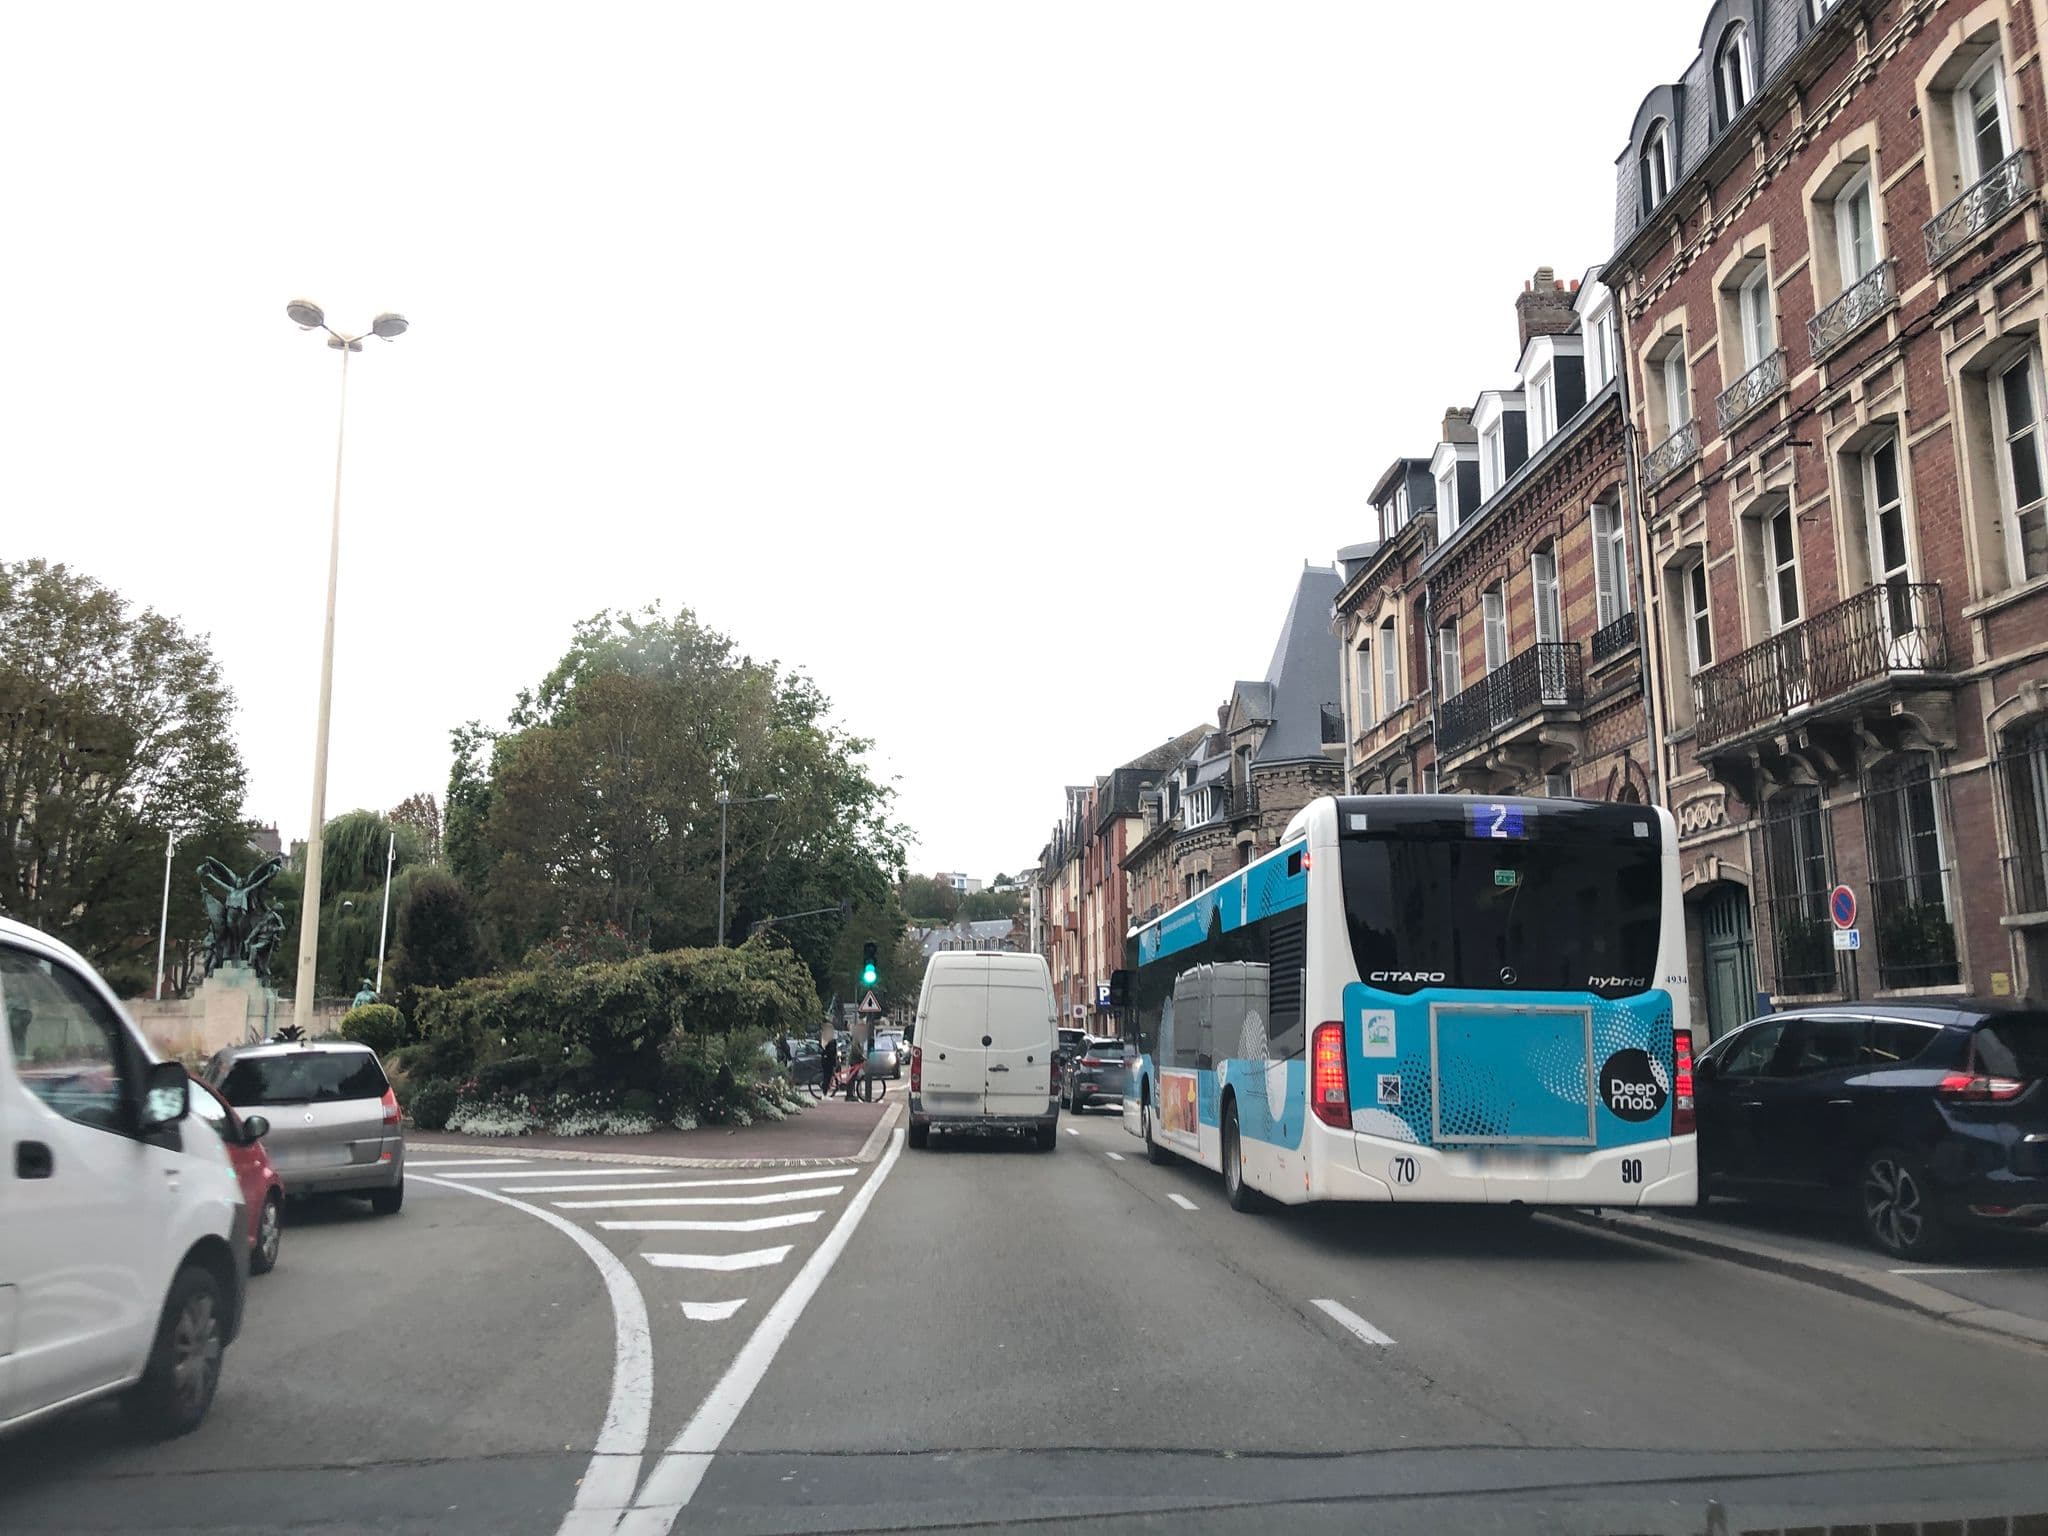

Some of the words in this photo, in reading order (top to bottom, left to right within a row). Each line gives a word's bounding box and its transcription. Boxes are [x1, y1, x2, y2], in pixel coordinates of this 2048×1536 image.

[1490, 803, 1508, 838] 2
[1370, 971, 1445, 982] CITARO
[1588, 976, 1645, 988] hybrid
[1099, 987, 1110, 1001] P
[1611, 1079, 1657, 1097] Deep
[1395, 1157, 1414, 1182] 70
[1622, 1159, 1642, 1183] 90
